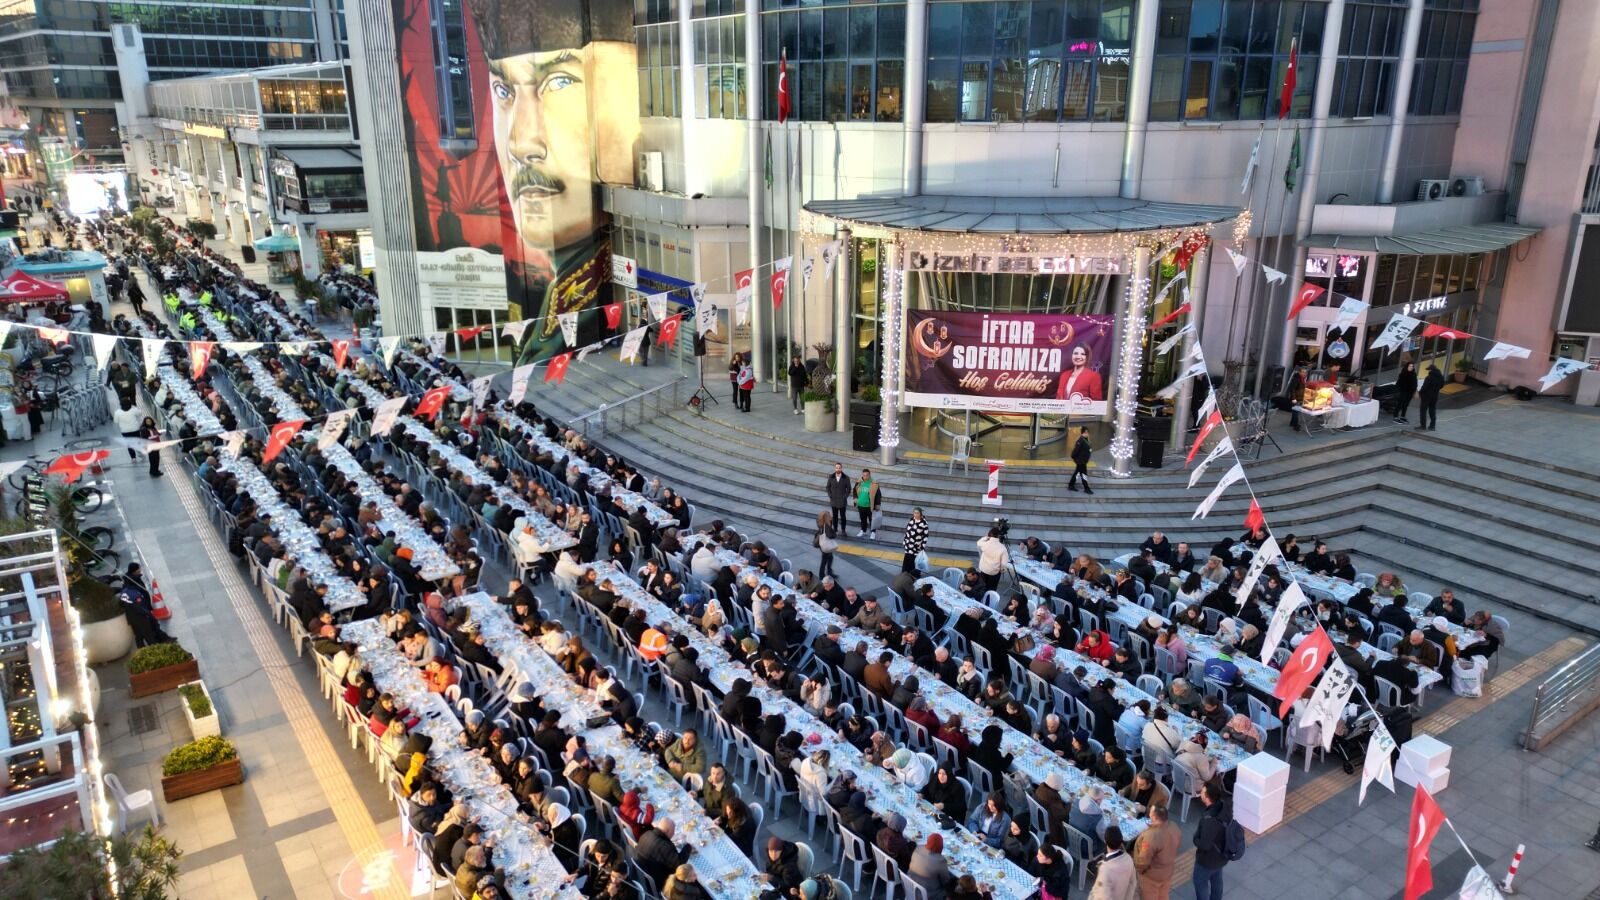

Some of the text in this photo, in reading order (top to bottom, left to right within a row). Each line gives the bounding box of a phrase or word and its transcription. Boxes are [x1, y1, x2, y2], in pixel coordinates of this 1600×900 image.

[933, 252, 1128, 275] İZMİT BELEDİYESİ
[982, 314, 1035, 345] İFTAR
[952, 346, 1062, 372] SOFRAMIZA
[958, 370, 1053, 394] Hoş Geldiniz
